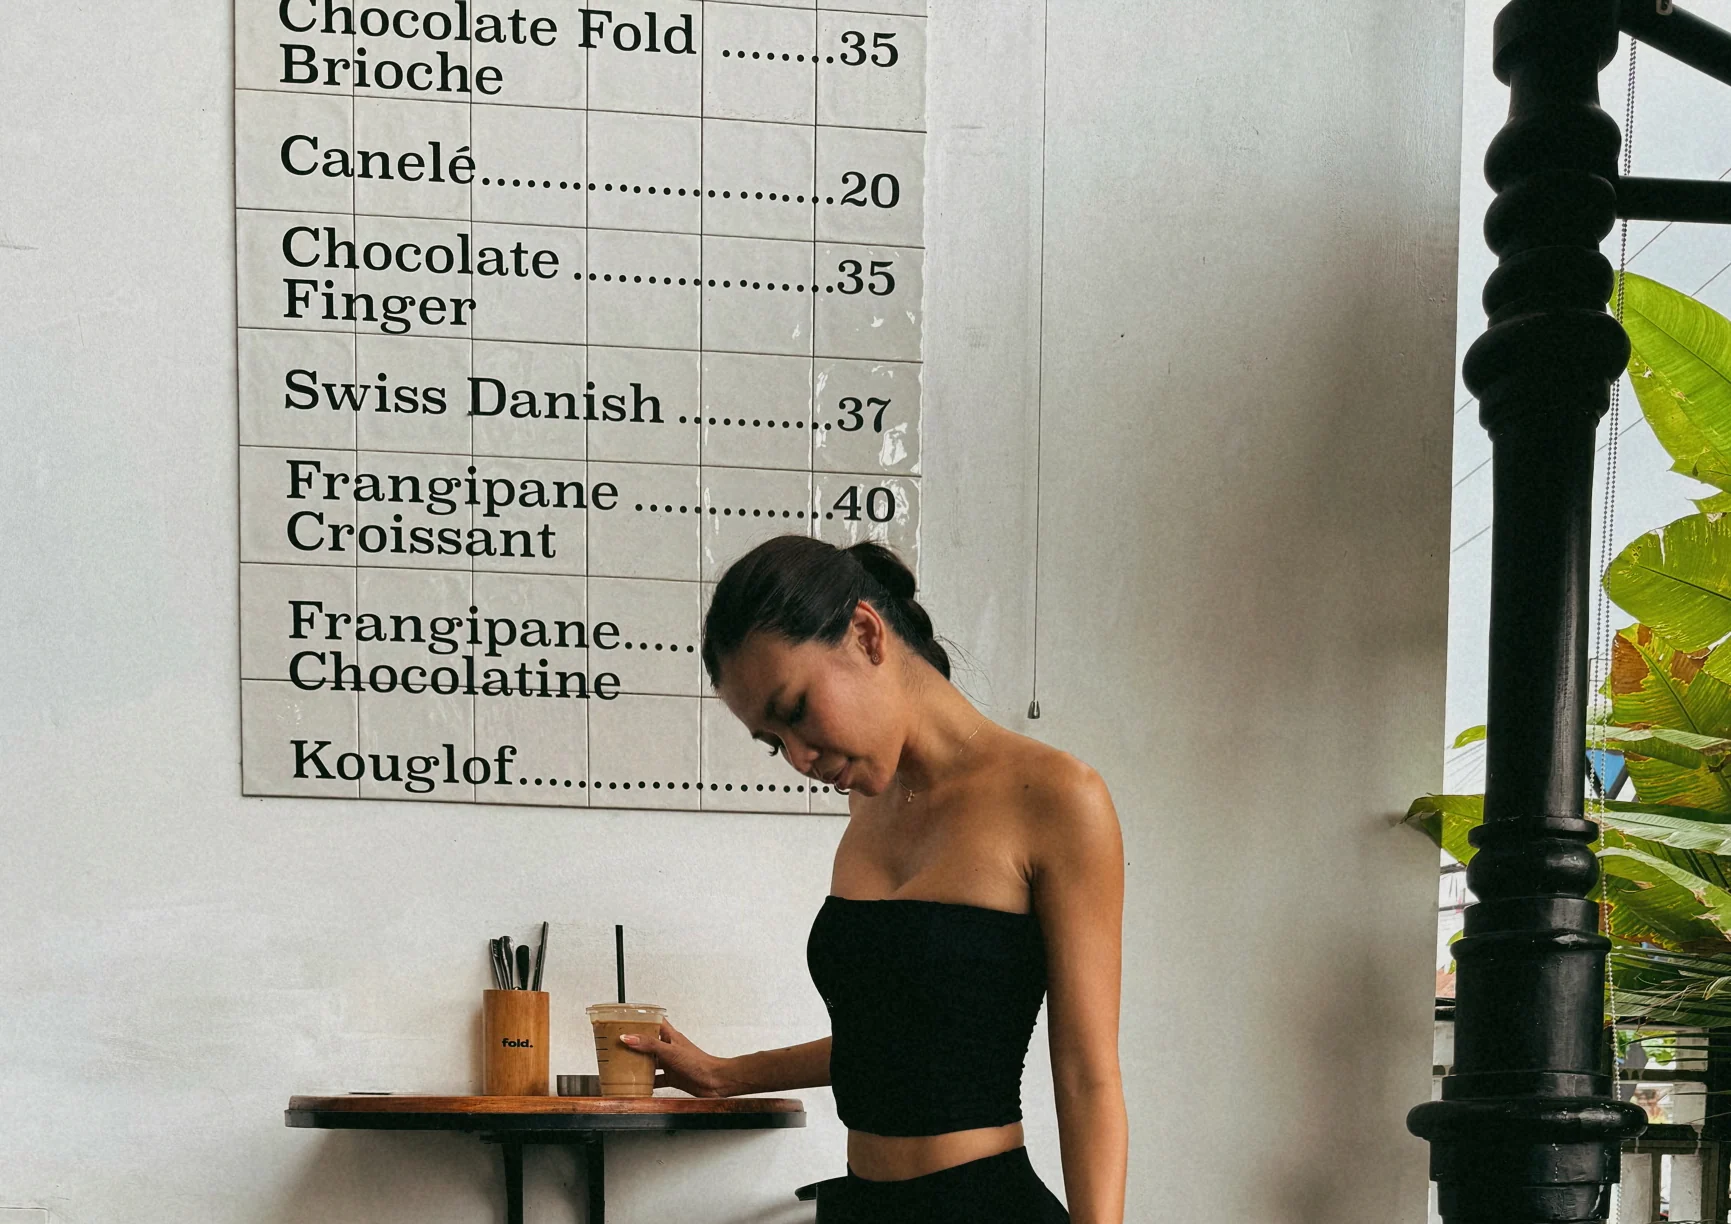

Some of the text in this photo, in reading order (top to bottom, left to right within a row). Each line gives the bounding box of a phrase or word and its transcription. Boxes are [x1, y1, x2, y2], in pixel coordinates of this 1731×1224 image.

[279, 0, 899, 68] Chocolate Fold 35
[279, 44, 503, 95] Brioche
[280, 135, 900, 209] Canelé 20
[282, 227, 896, 296] Chocolate 35
[283, 279, 477, 335] Finger
[285, 370, 892, 433] Swiss Danish 37
[286, 460, 896, 523] Frangipane 40
[287, 511, 557, 558] Croissant
[288, 601, 620, 658] Frangipane
[288, 652, 621, 701] Chocolatine
[290, 740, 517, 794] Kouglof
[502, 1037, 534, 1049] fold.
